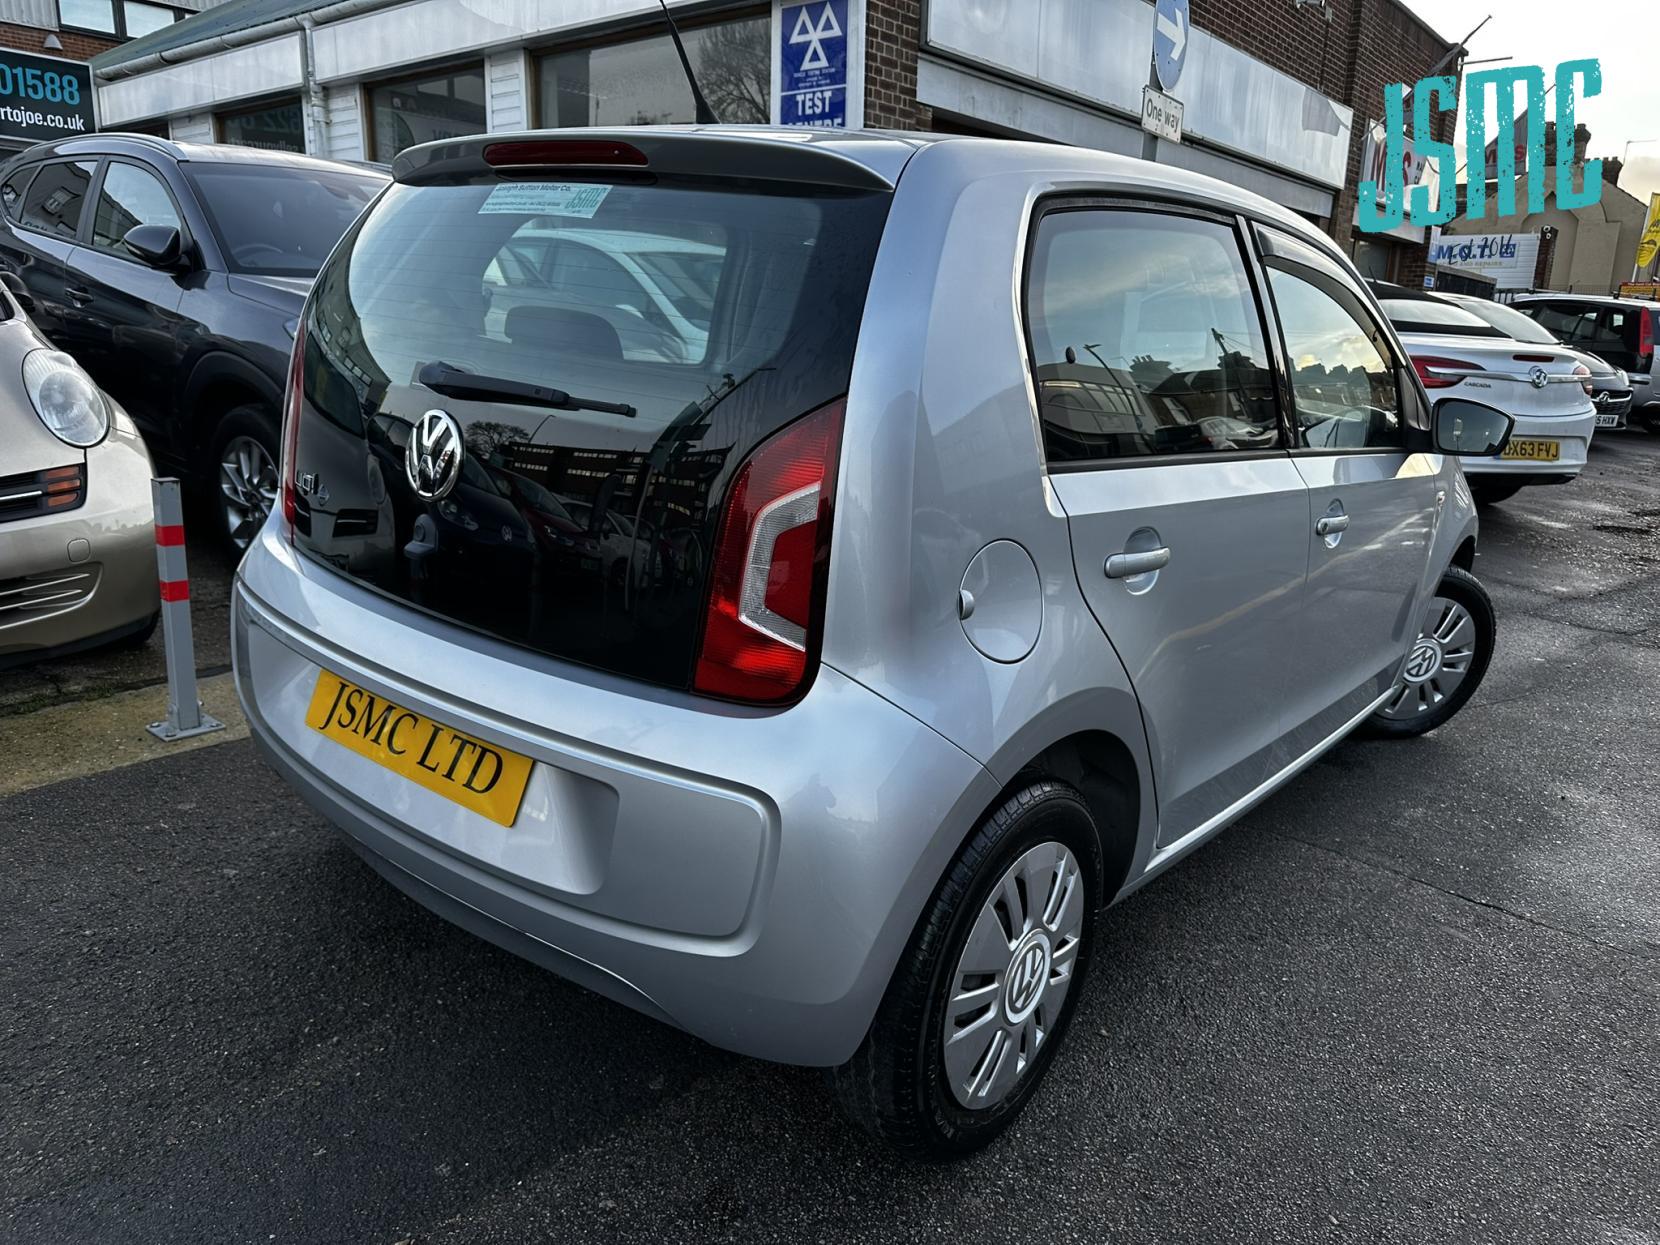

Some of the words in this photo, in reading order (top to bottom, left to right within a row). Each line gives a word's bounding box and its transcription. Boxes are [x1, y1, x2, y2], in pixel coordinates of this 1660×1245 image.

[0, 63, 80, 105] 01588
[0, 106, 85, 131] rtojoe.co.uk
[796, 90, 832, 116] TEST
[1146, 98, 1162, 122] One
[1165, 111, 1180, 133] way
[319, 681, 418, 755] JSMC
[416, 723, 503, 794] LTD
